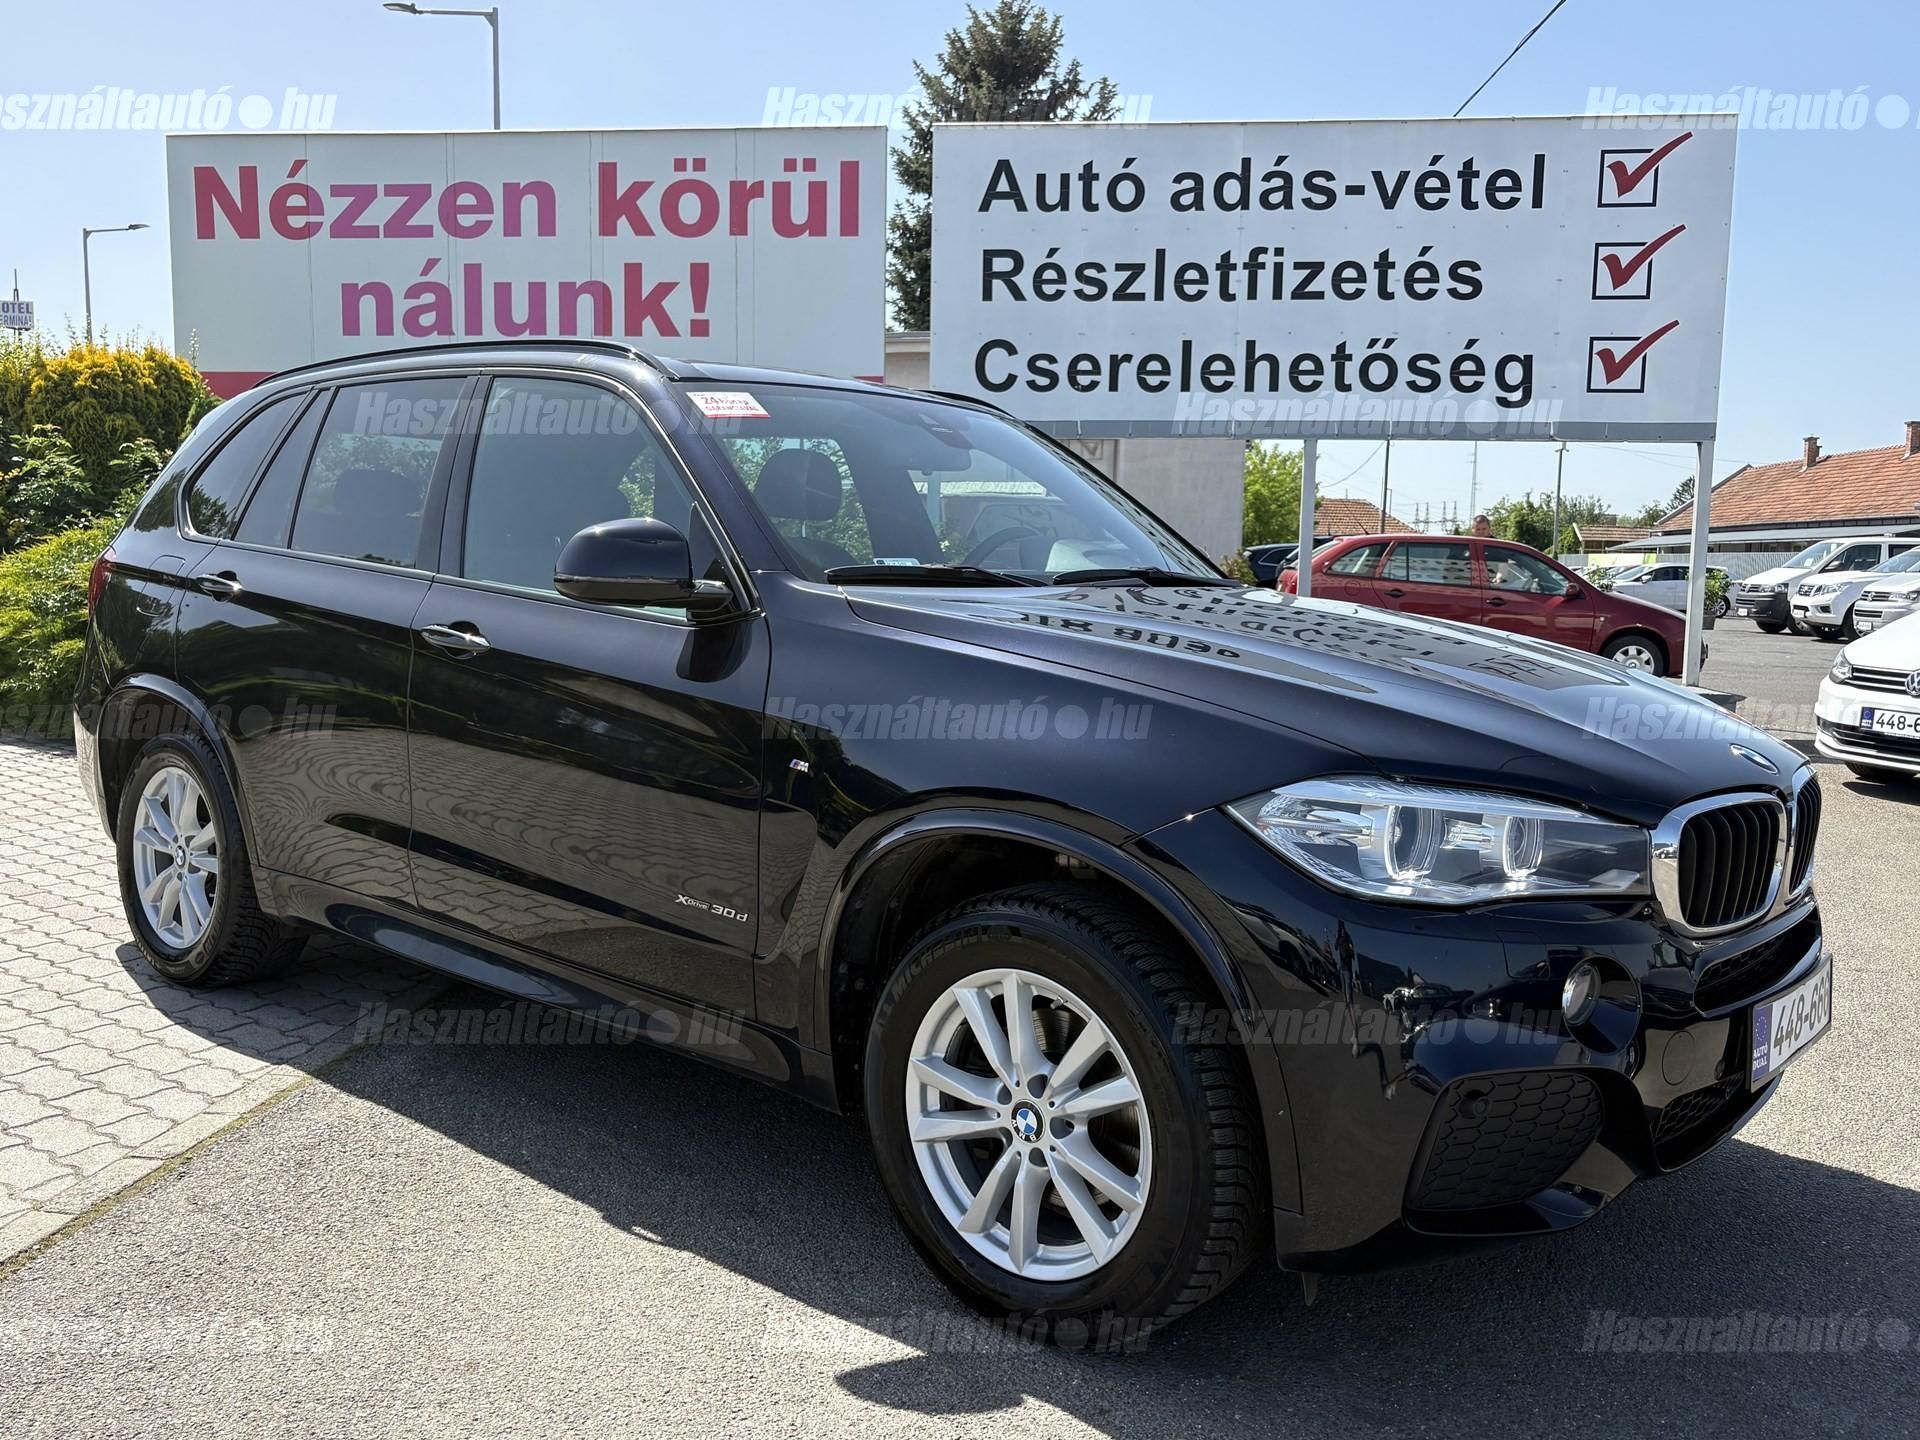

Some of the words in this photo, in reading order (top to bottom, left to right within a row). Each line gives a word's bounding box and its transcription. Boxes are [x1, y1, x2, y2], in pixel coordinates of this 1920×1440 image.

[193, 160, 558, 241] Nézzen
[598, 157, 861, 237] körül
[978, 157, 1146, 213] Autó
[1170, 153, 1546, 211] adás-vétel
[341, 258, 711, 338] nálunk!
[982, 245, 1484, 302] Részletfizetés
[0, 302, 32, 314] OTEL
[974, 336, 1535, 409] Cserelehetőség
